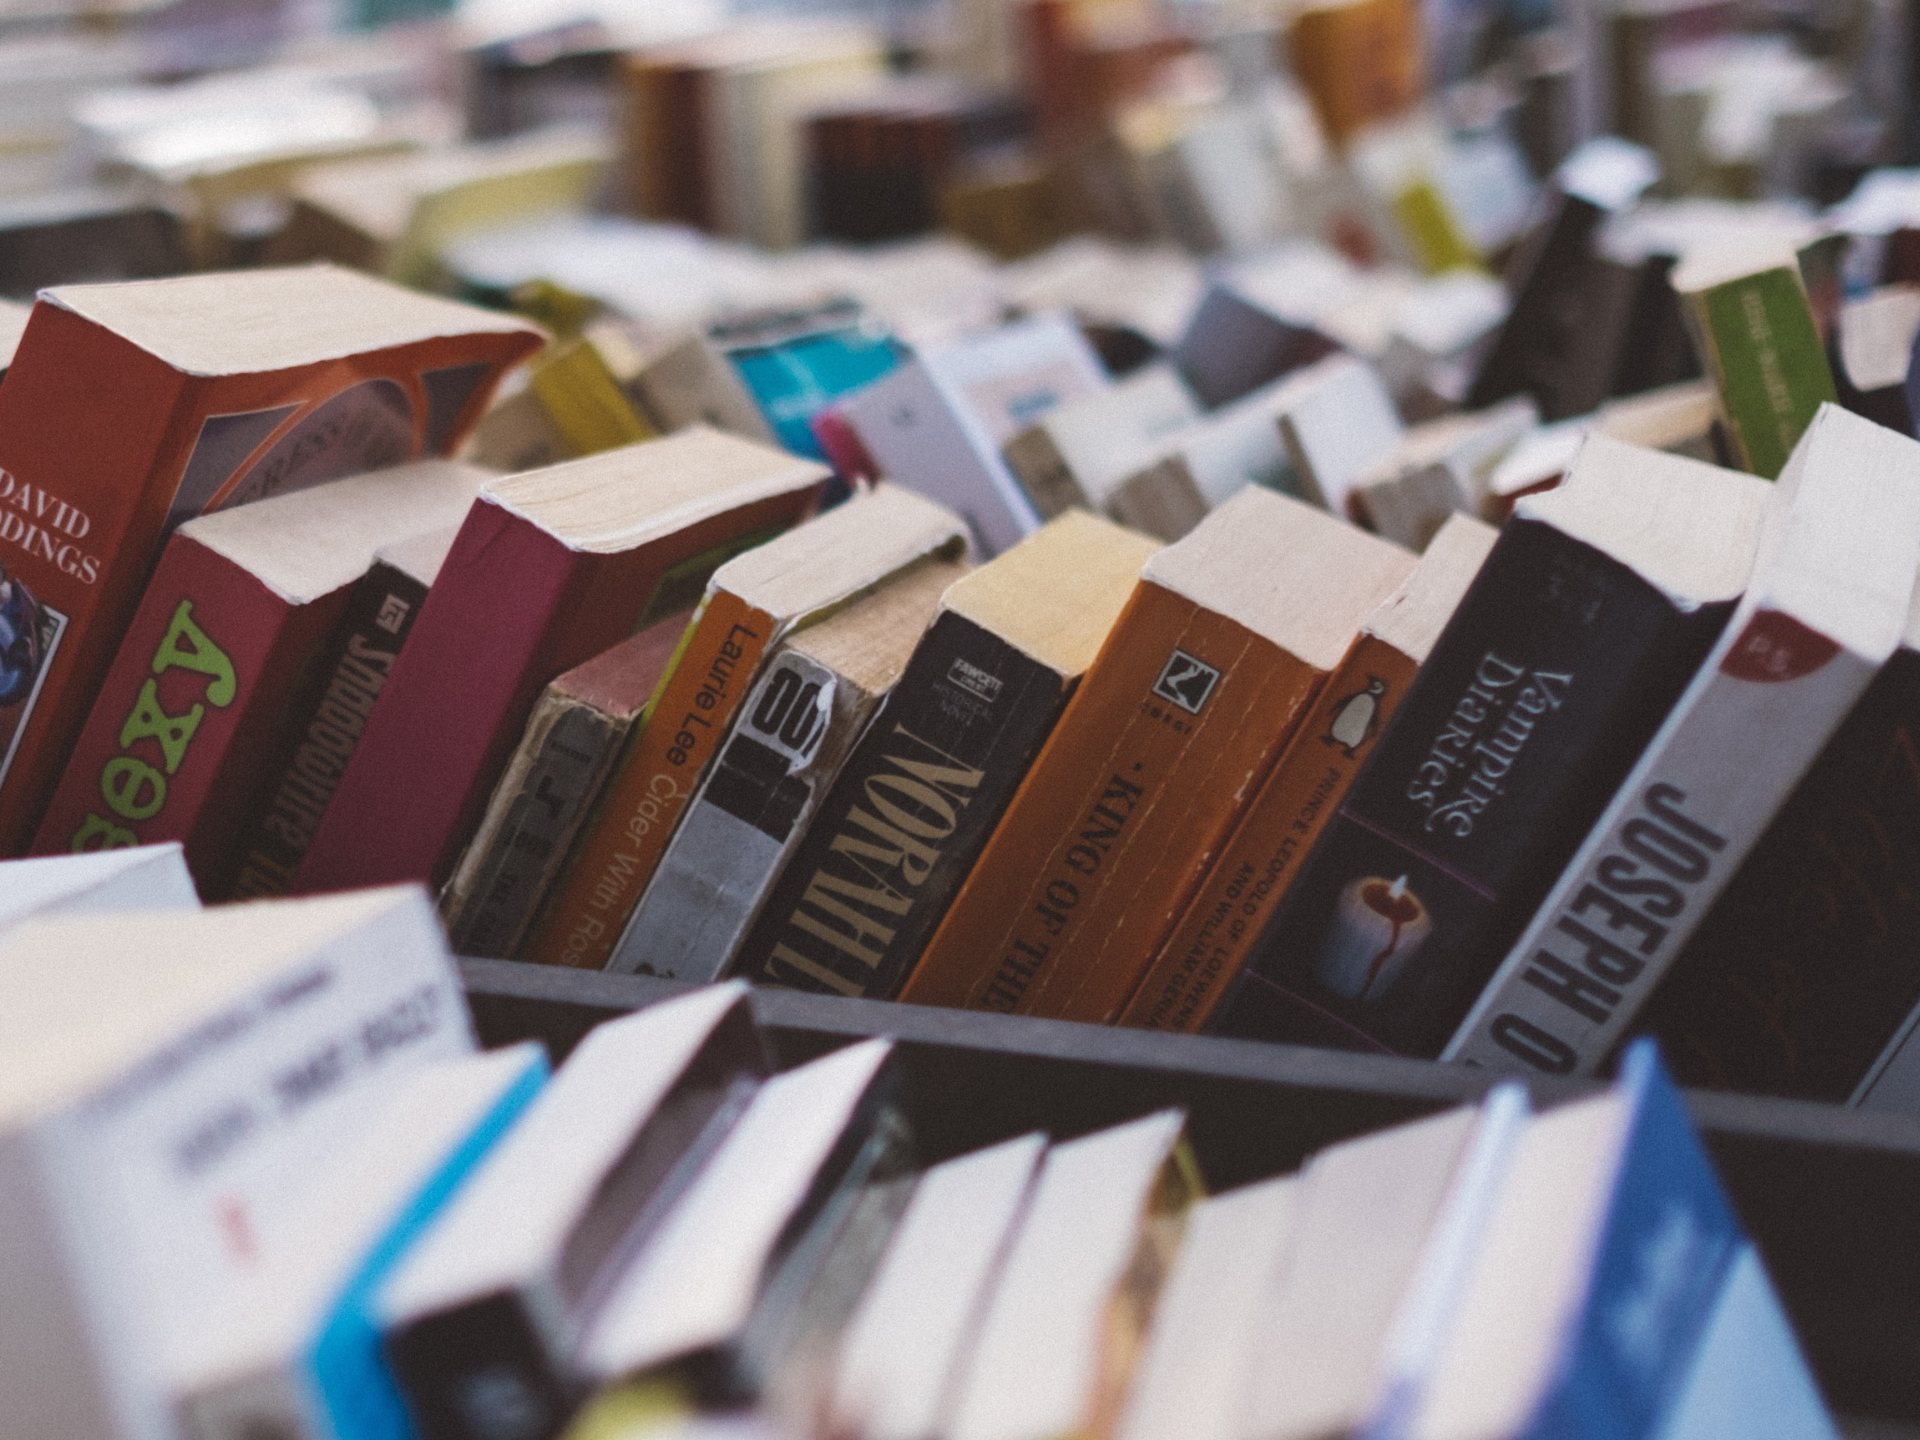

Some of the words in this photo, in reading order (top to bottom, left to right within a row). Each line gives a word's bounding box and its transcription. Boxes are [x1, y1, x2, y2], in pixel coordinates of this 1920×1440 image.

[0, 467, 90, 538] DAVID
[0, 508, 100, 584] DINGS
[695, 622, 758, 711] Laurie
[665, 711, 712, 767] Lee
[1407, 652, 1525, 802] Diaries
[1424, 668, 1576, 837] Vampire
[625, 773, 678, 848] Cider
[1064, 773, 1145, 875] KING
[1292, 766, 1343, 835] PRINCE
[590, 851, 640, 910] With
[789, 722, 986, 970] NORAH
[1225, 860, 1256, 899] AND
[1242, 836, 1298, 917] LEOPOLD
[1034, 878, 1080, 939] OF
[1182, 900, 1233, 973] WILLIAM
[1228, 918, 1248, 943] OF
[1518, 781, 1730, 1026] JOSEPH
[981, 938, 1049, 1015] THE
[1468, 1013, 1577, 1075] O
